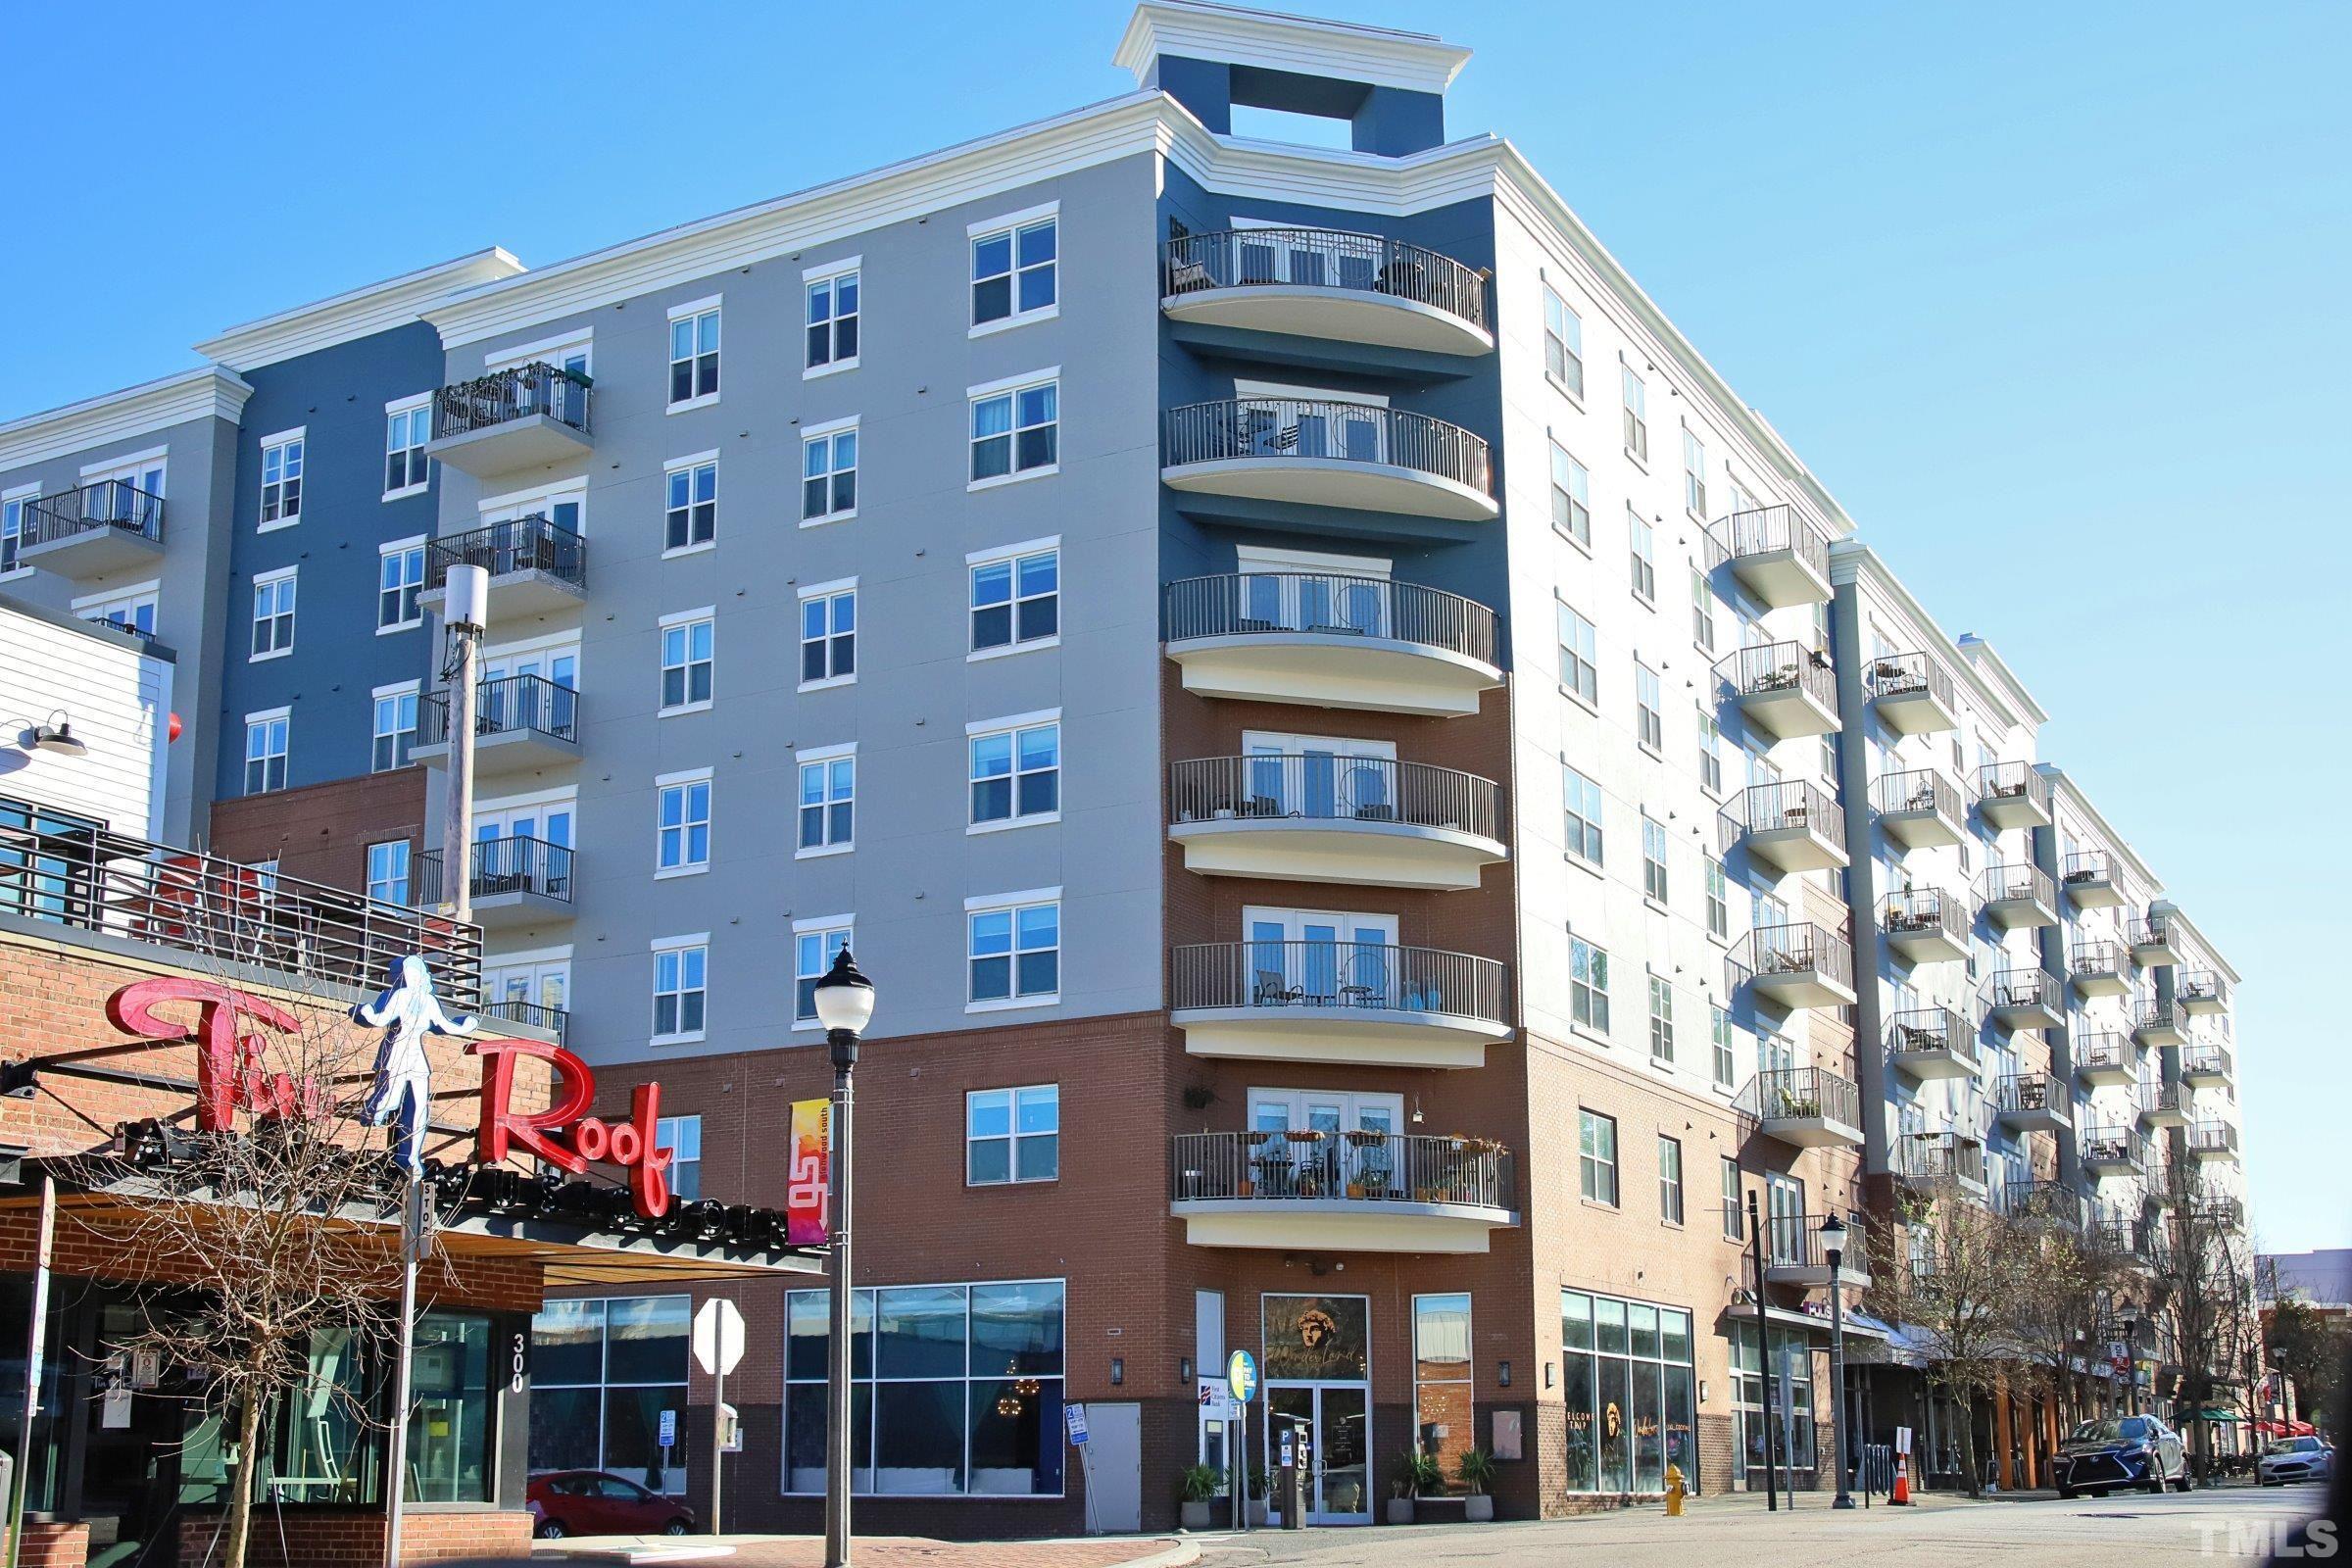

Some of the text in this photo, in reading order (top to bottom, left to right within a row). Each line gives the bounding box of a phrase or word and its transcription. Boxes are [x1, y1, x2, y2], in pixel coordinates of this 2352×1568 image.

[105, 976, 335, 1132] Tin
[464, 1039, 673, 1218] Roof
[819, 1107, 828, 1179] lenwood south
[662, 1193, 790, 1249] JOIN
[1808, 1301, 1847, 1322] POLISD
[512, 1333, 524, 1394] 300
[1282, 1430, 1290, 1442] P
[1567, 1411, 1595, 1422] ELCOME
